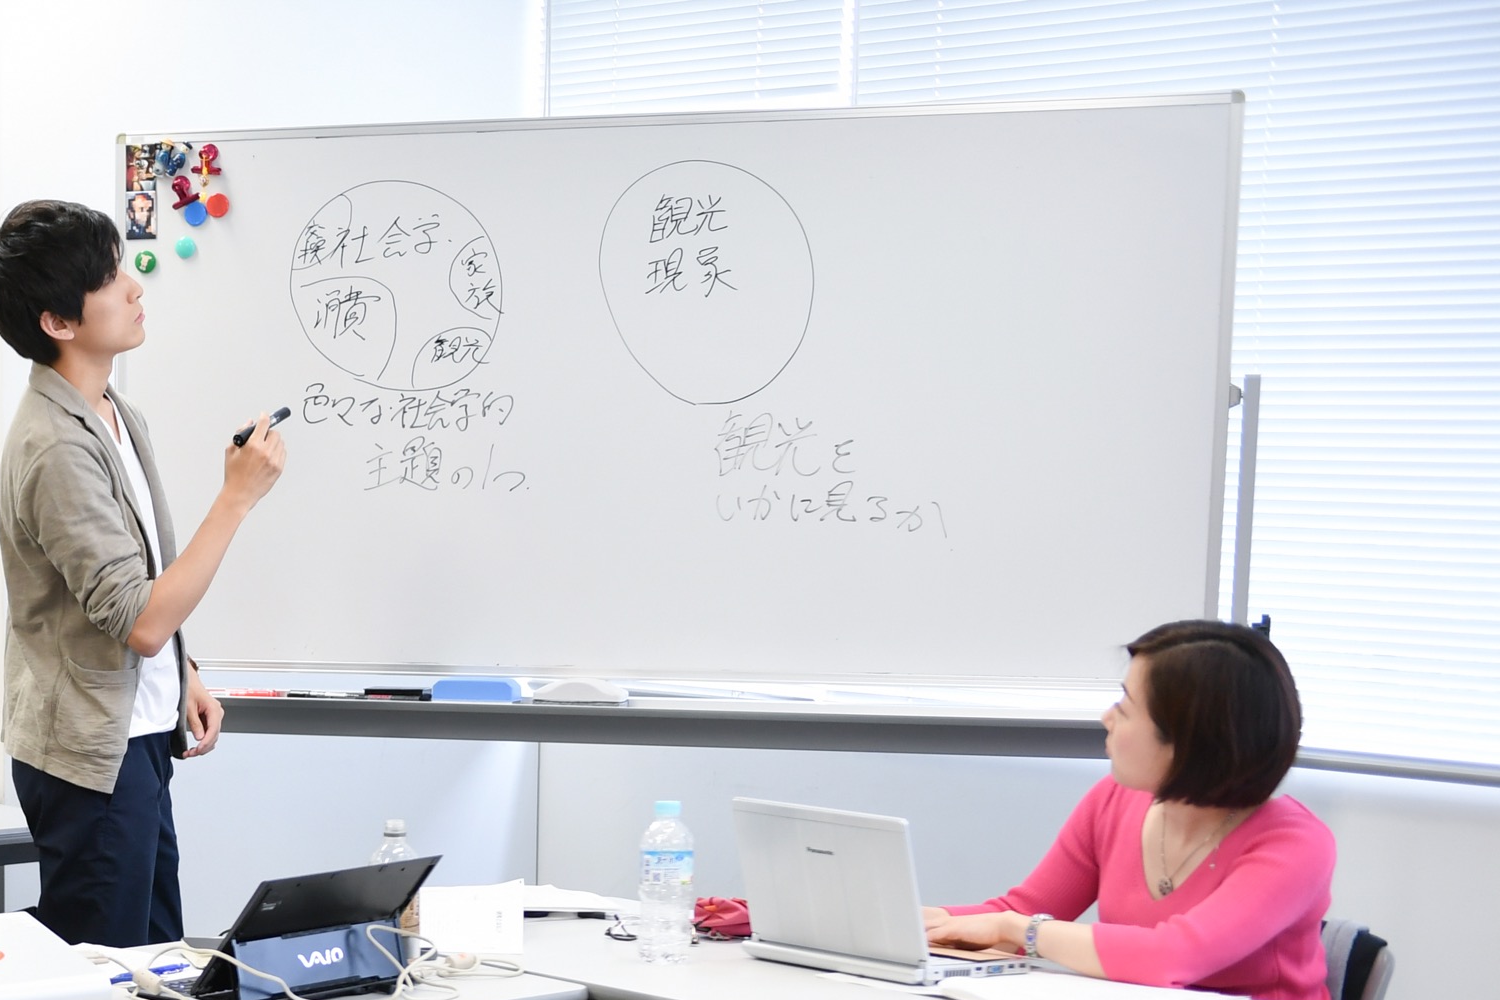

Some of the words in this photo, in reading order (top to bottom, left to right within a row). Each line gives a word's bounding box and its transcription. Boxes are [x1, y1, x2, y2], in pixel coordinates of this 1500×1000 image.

[649, 193, 728, 243] 観光
[645, 246, 738, 298] 現象
[313, 285, 381, 341] 消費
[431, 335, 490, 364] 観光
[302, 382, 514, 432] 色々な社会学的
[714, 410, 855, 477] 観光を
[716, 480, 948, 539] いかに見るか
[297, 946, 344, 968] VAIO
